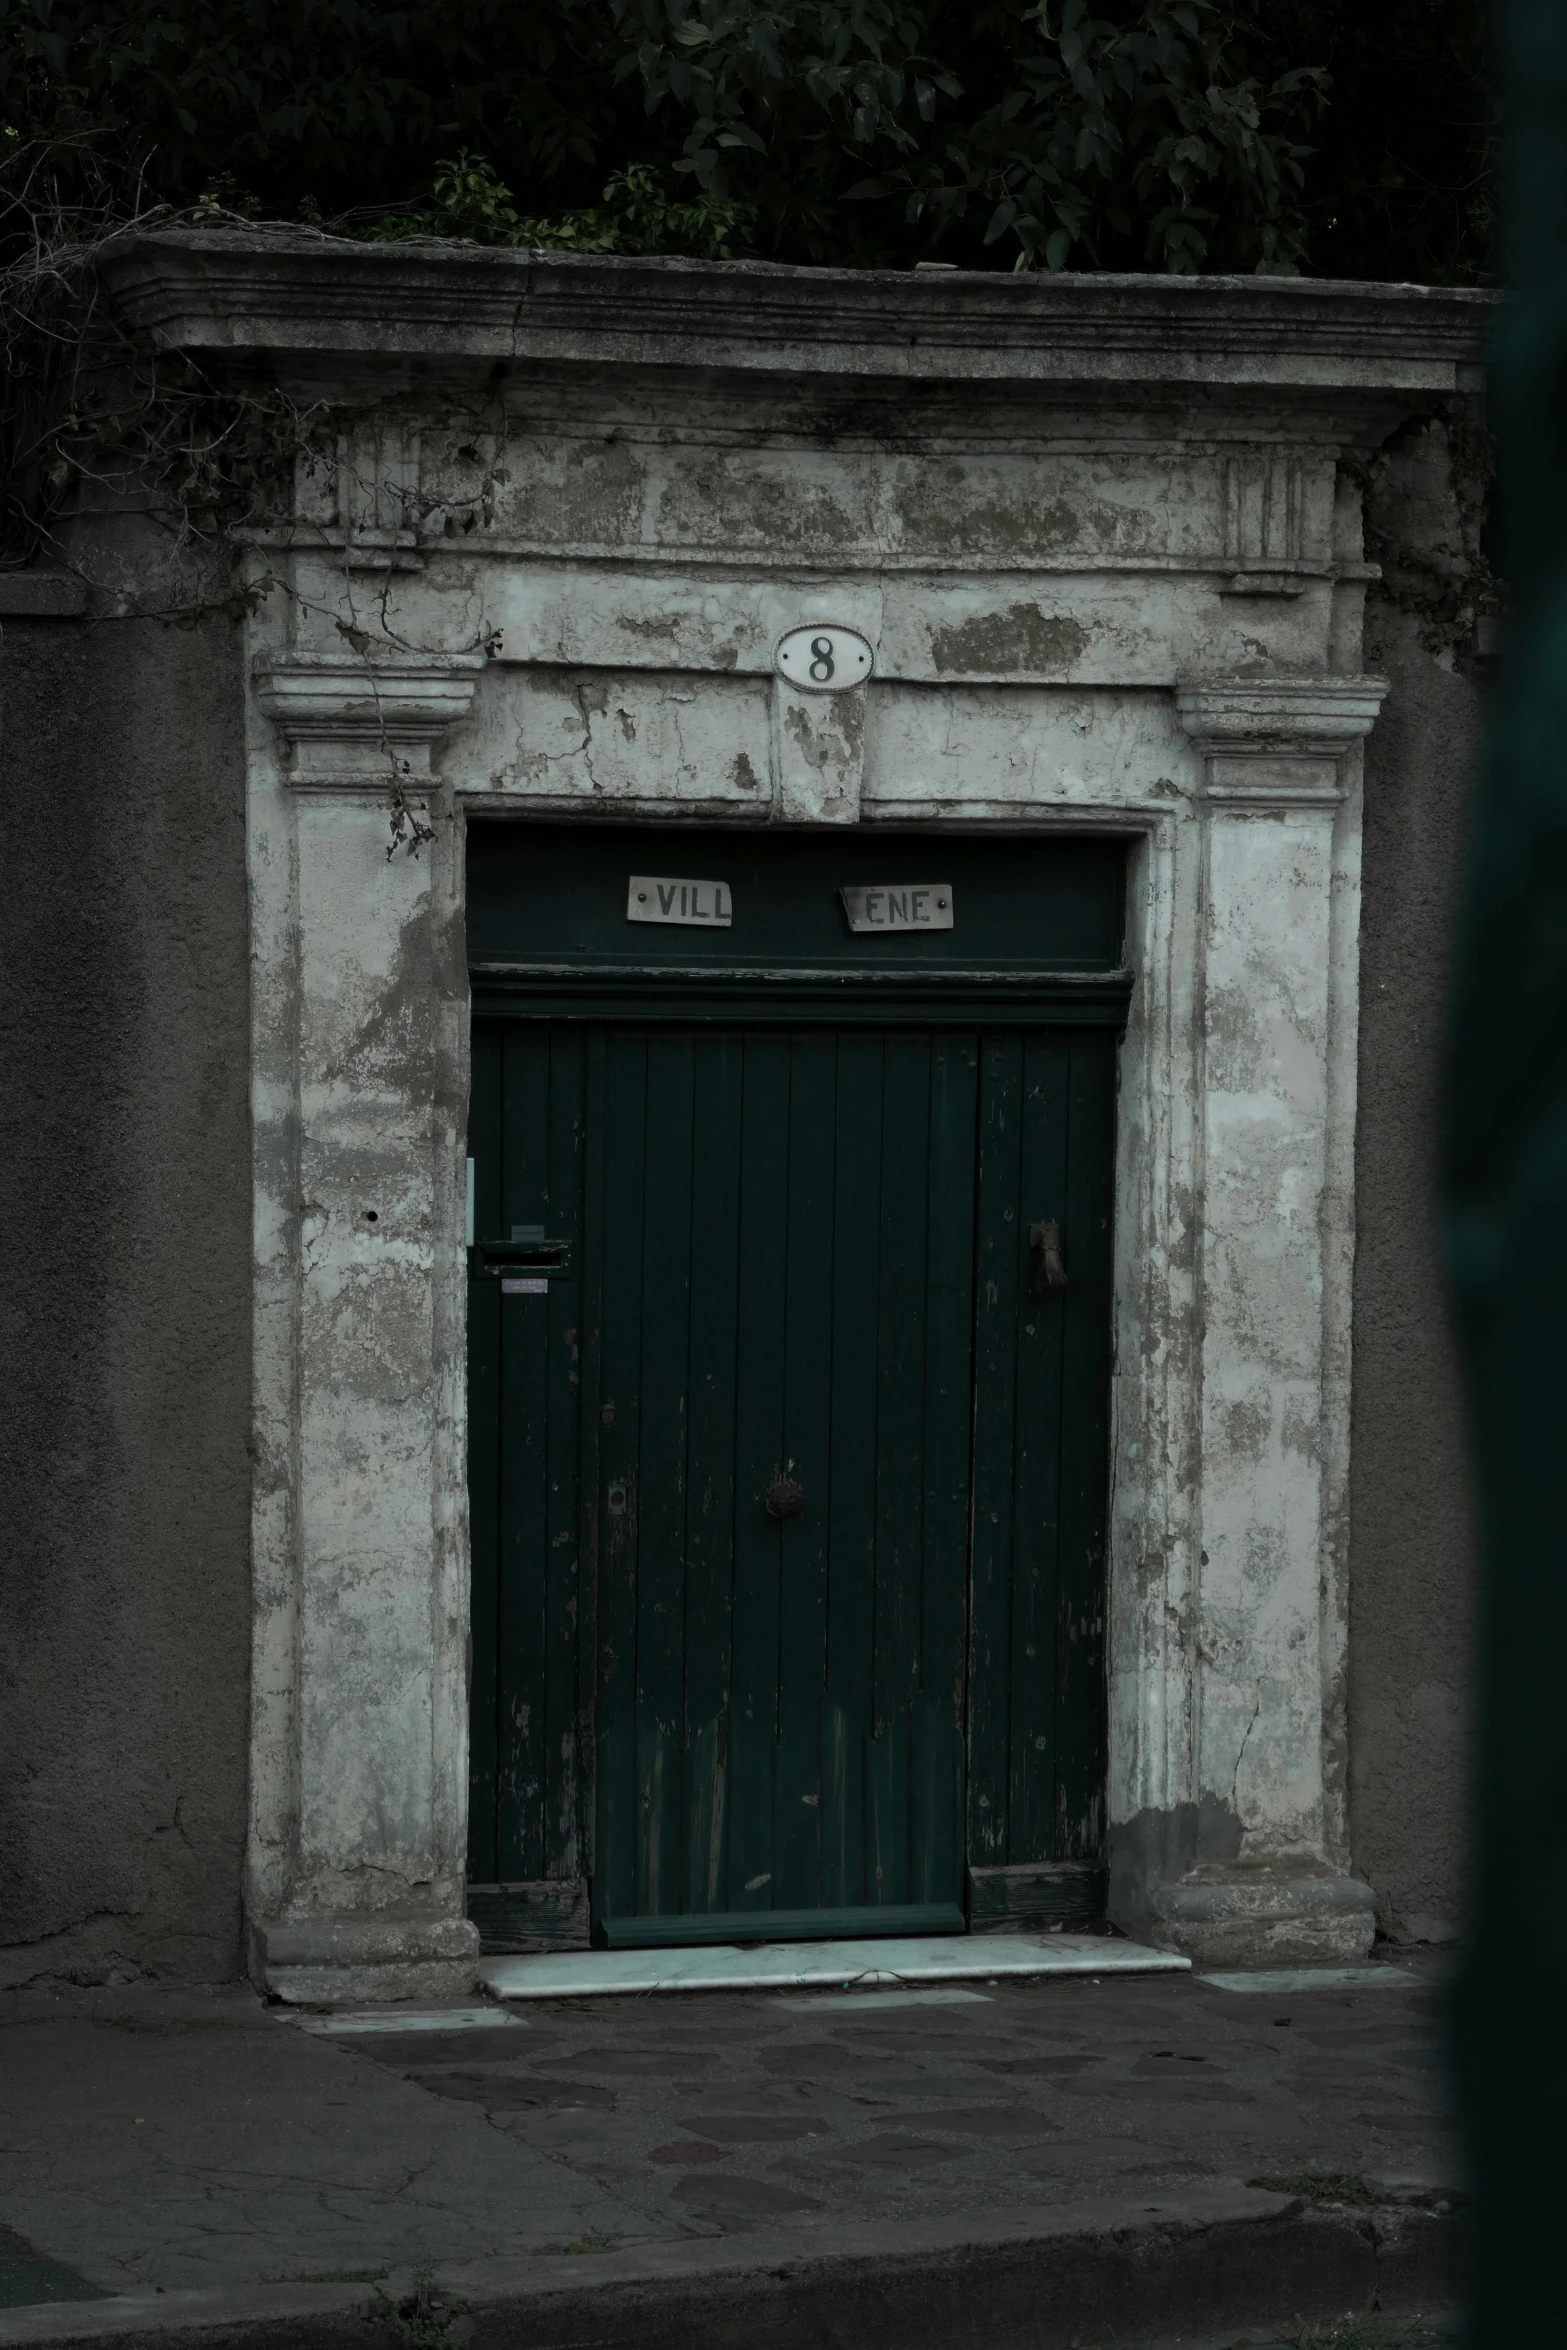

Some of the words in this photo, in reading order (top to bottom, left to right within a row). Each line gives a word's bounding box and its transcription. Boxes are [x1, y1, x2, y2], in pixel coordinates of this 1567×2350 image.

[808, 636, 835, 683] 8
[657, 884, 731, 919] VILL
[865, 890, 931, 924] ENE
